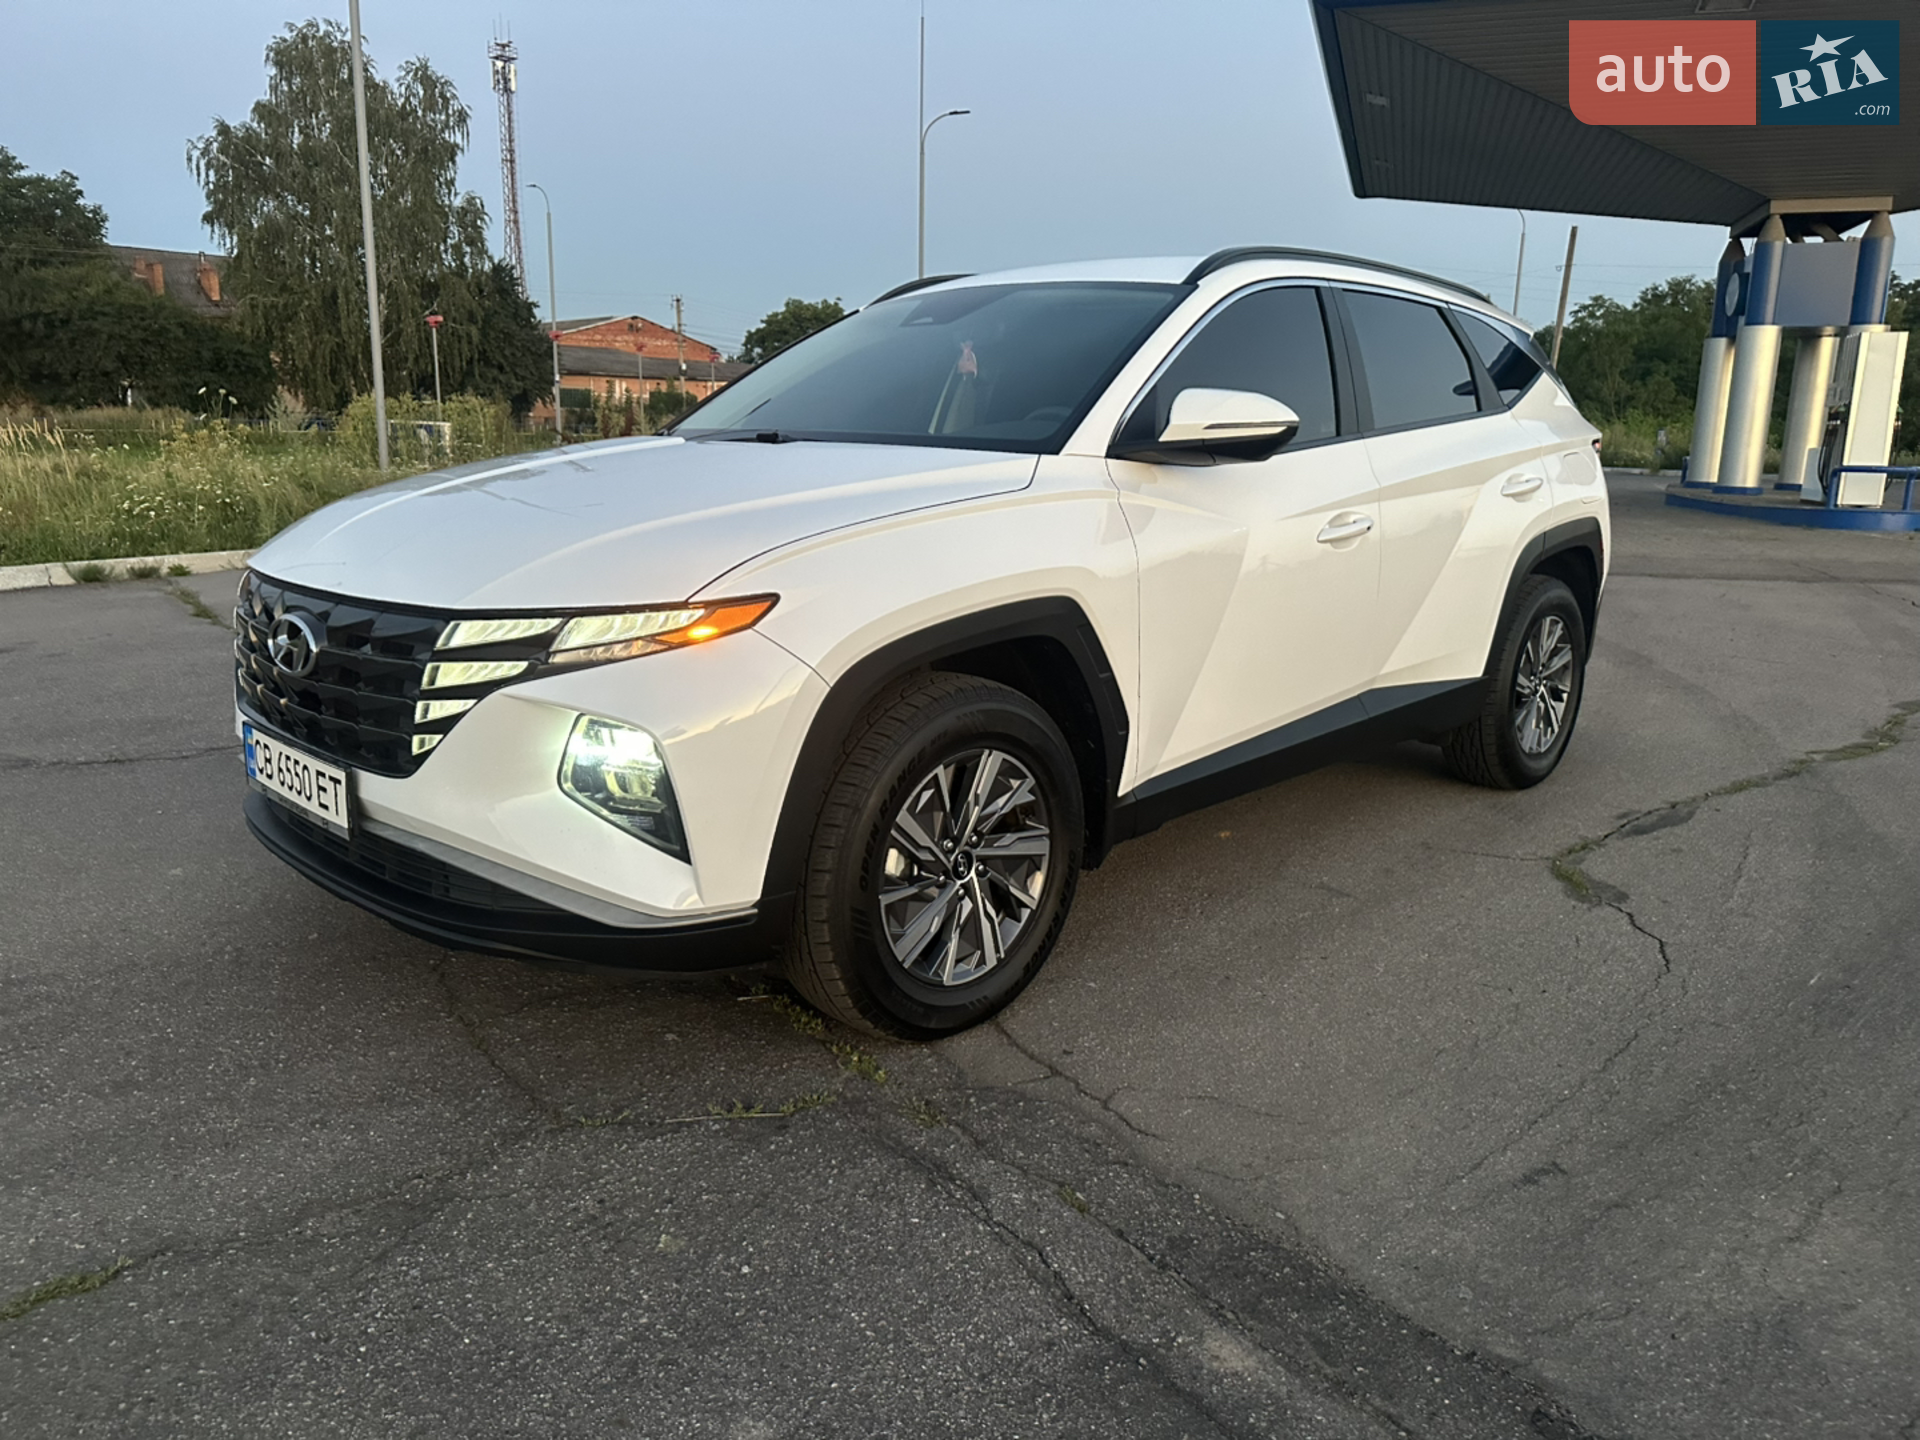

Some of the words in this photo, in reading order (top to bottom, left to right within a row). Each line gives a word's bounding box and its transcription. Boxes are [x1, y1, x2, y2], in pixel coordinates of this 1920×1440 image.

[255, 739, 273, 780] CB
[277, 751, 312, 802] 6550
[315, 769, 342, 816] ET
[859, 821, 880, 891] OPEN
[878, 746, 927, 820] RANGE
